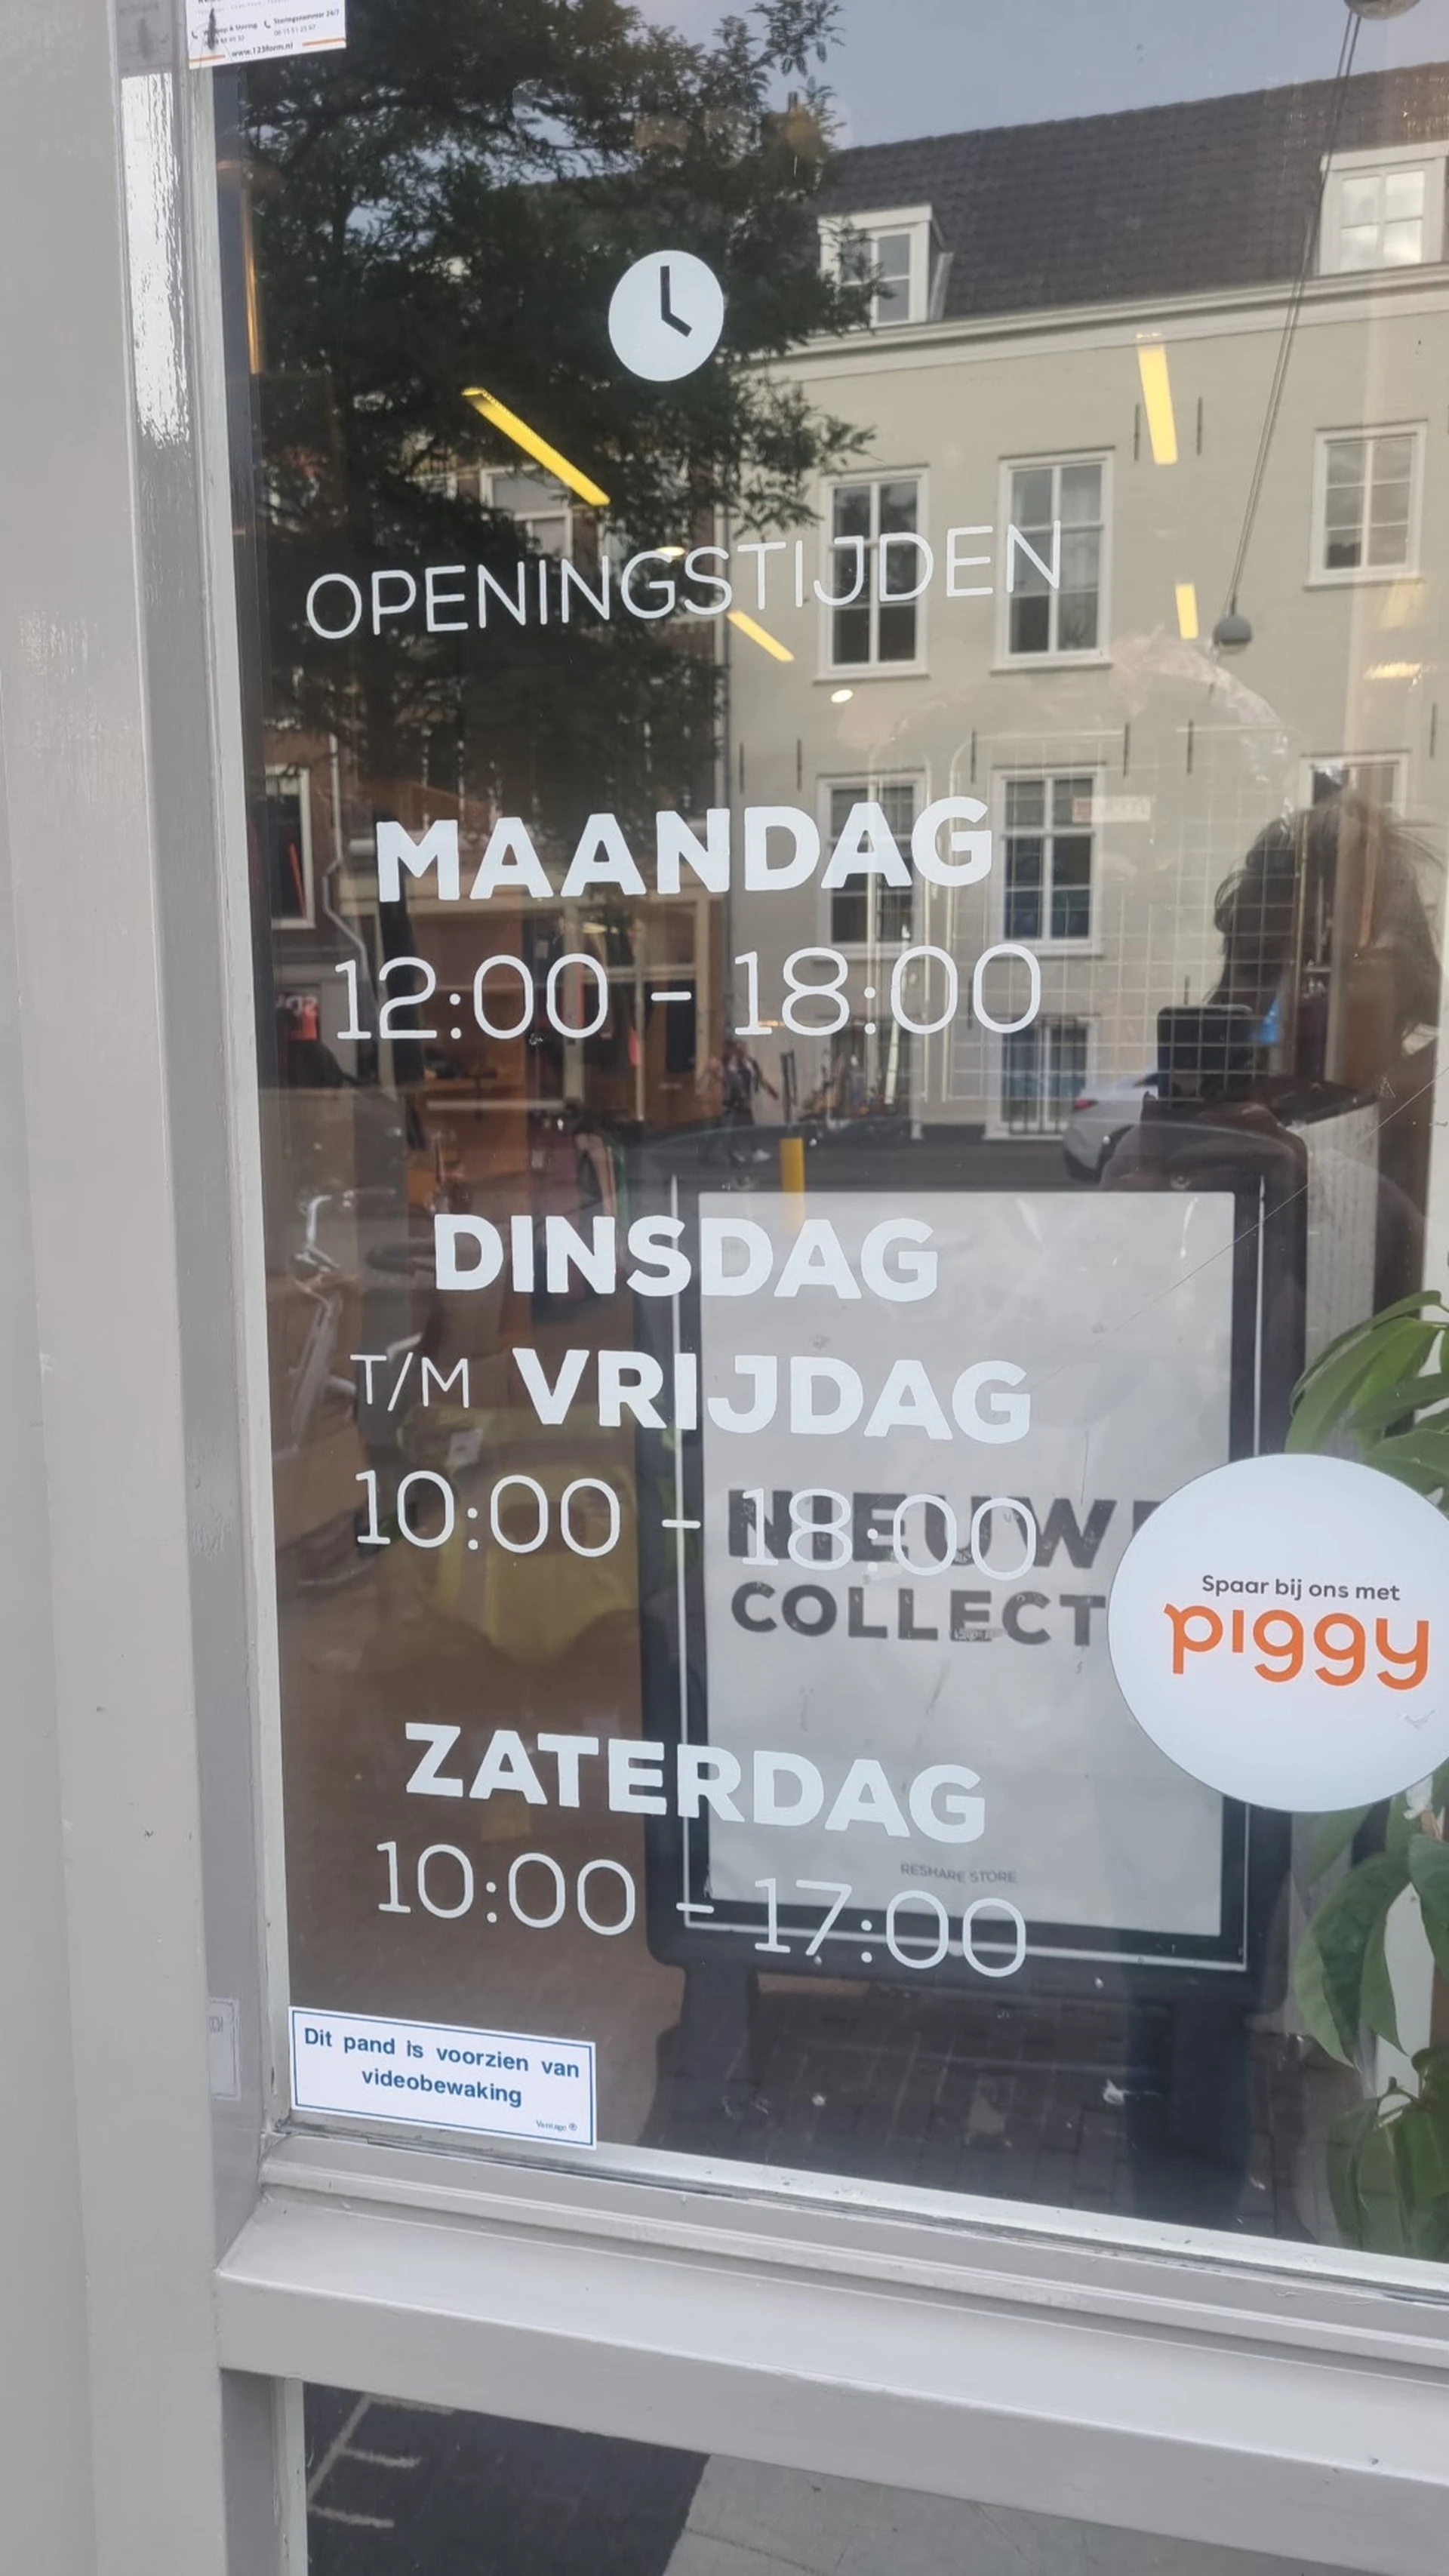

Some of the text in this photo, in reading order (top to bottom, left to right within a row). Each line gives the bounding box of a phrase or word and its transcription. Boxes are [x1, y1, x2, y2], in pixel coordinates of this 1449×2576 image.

[232, 42, 294, 58] www.123form.nl
[326, 8, 340, 18] 24/7
[306, 519, 1061, 639] OPENINGSTIJDEN
[376, 796, 993, 903] MAANDAG
[334, 953, 611, 1041] 12:00
[734, 943, 1042, 1036] 18:00
[433, 1213, 939, 1303] DINSDAG
[349, 1346, 1032, 1445] T/M VRIJDAG
[355, 1468, 622, 1558] 10:00
[742, 1487, 1038, 1580] 18:00
[731, 1581, 1106, 1647] COLLECT
[1201, 1574, 1401, 1602] Spaar bij ons met
[1162, 1602, 1429, 1691] piggy
[405, 1722, 986, 1844] ZATERDAG
[376, 1840, 636, 1937] 10:00
[753, 1877, 1028, 1978] 17:00
[900, 1862, 1017, 1884] RESHARE STORE
[304, 2027, 580, 2079] Dit pand is voorzien van
[361, 2067, 522, 2108] videobewaking
